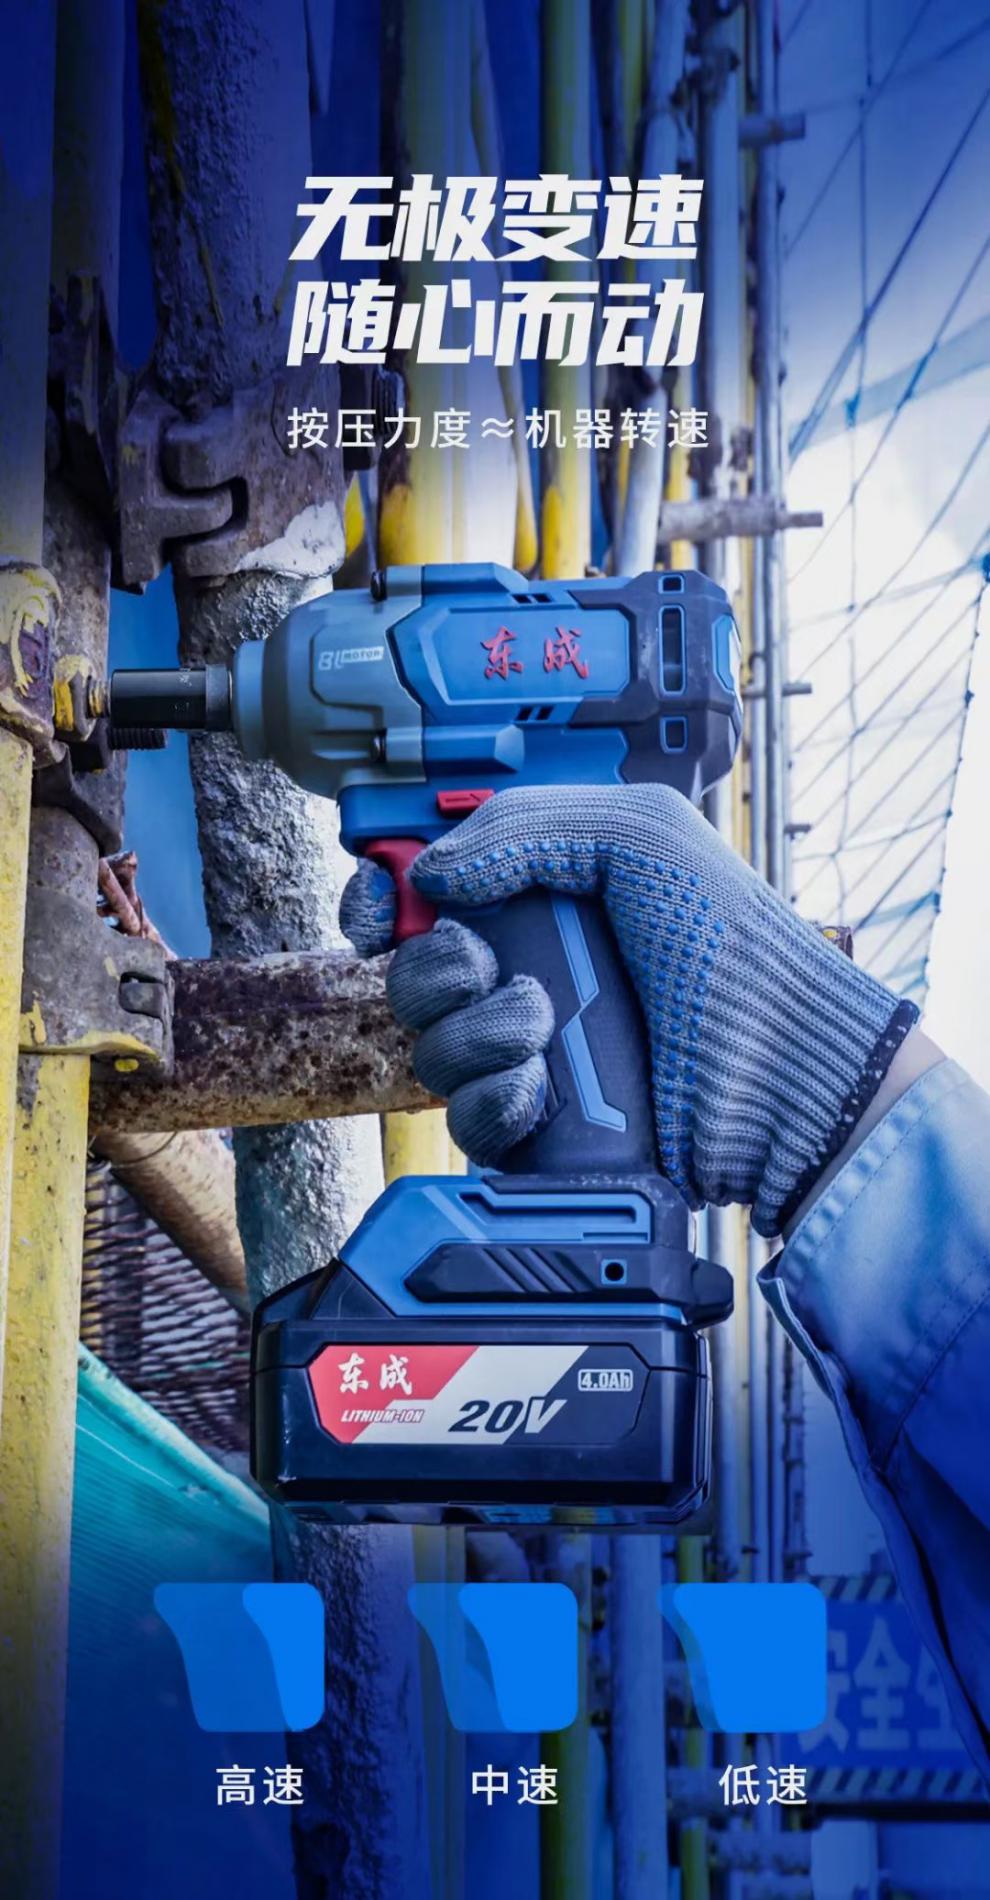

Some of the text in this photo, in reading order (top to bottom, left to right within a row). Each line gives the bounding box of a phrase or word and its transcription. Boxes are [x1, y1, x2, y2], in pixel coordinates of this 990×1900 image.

[480, 626, 590, 680] 东成
[338, 1353, 413, 1395] 东成
[580, 1371, 631, 1390] 4.0Ah
[340, 1408, 424, 1424] LITHIUM-ION
[448, 1397, 568, 1434] 20V
